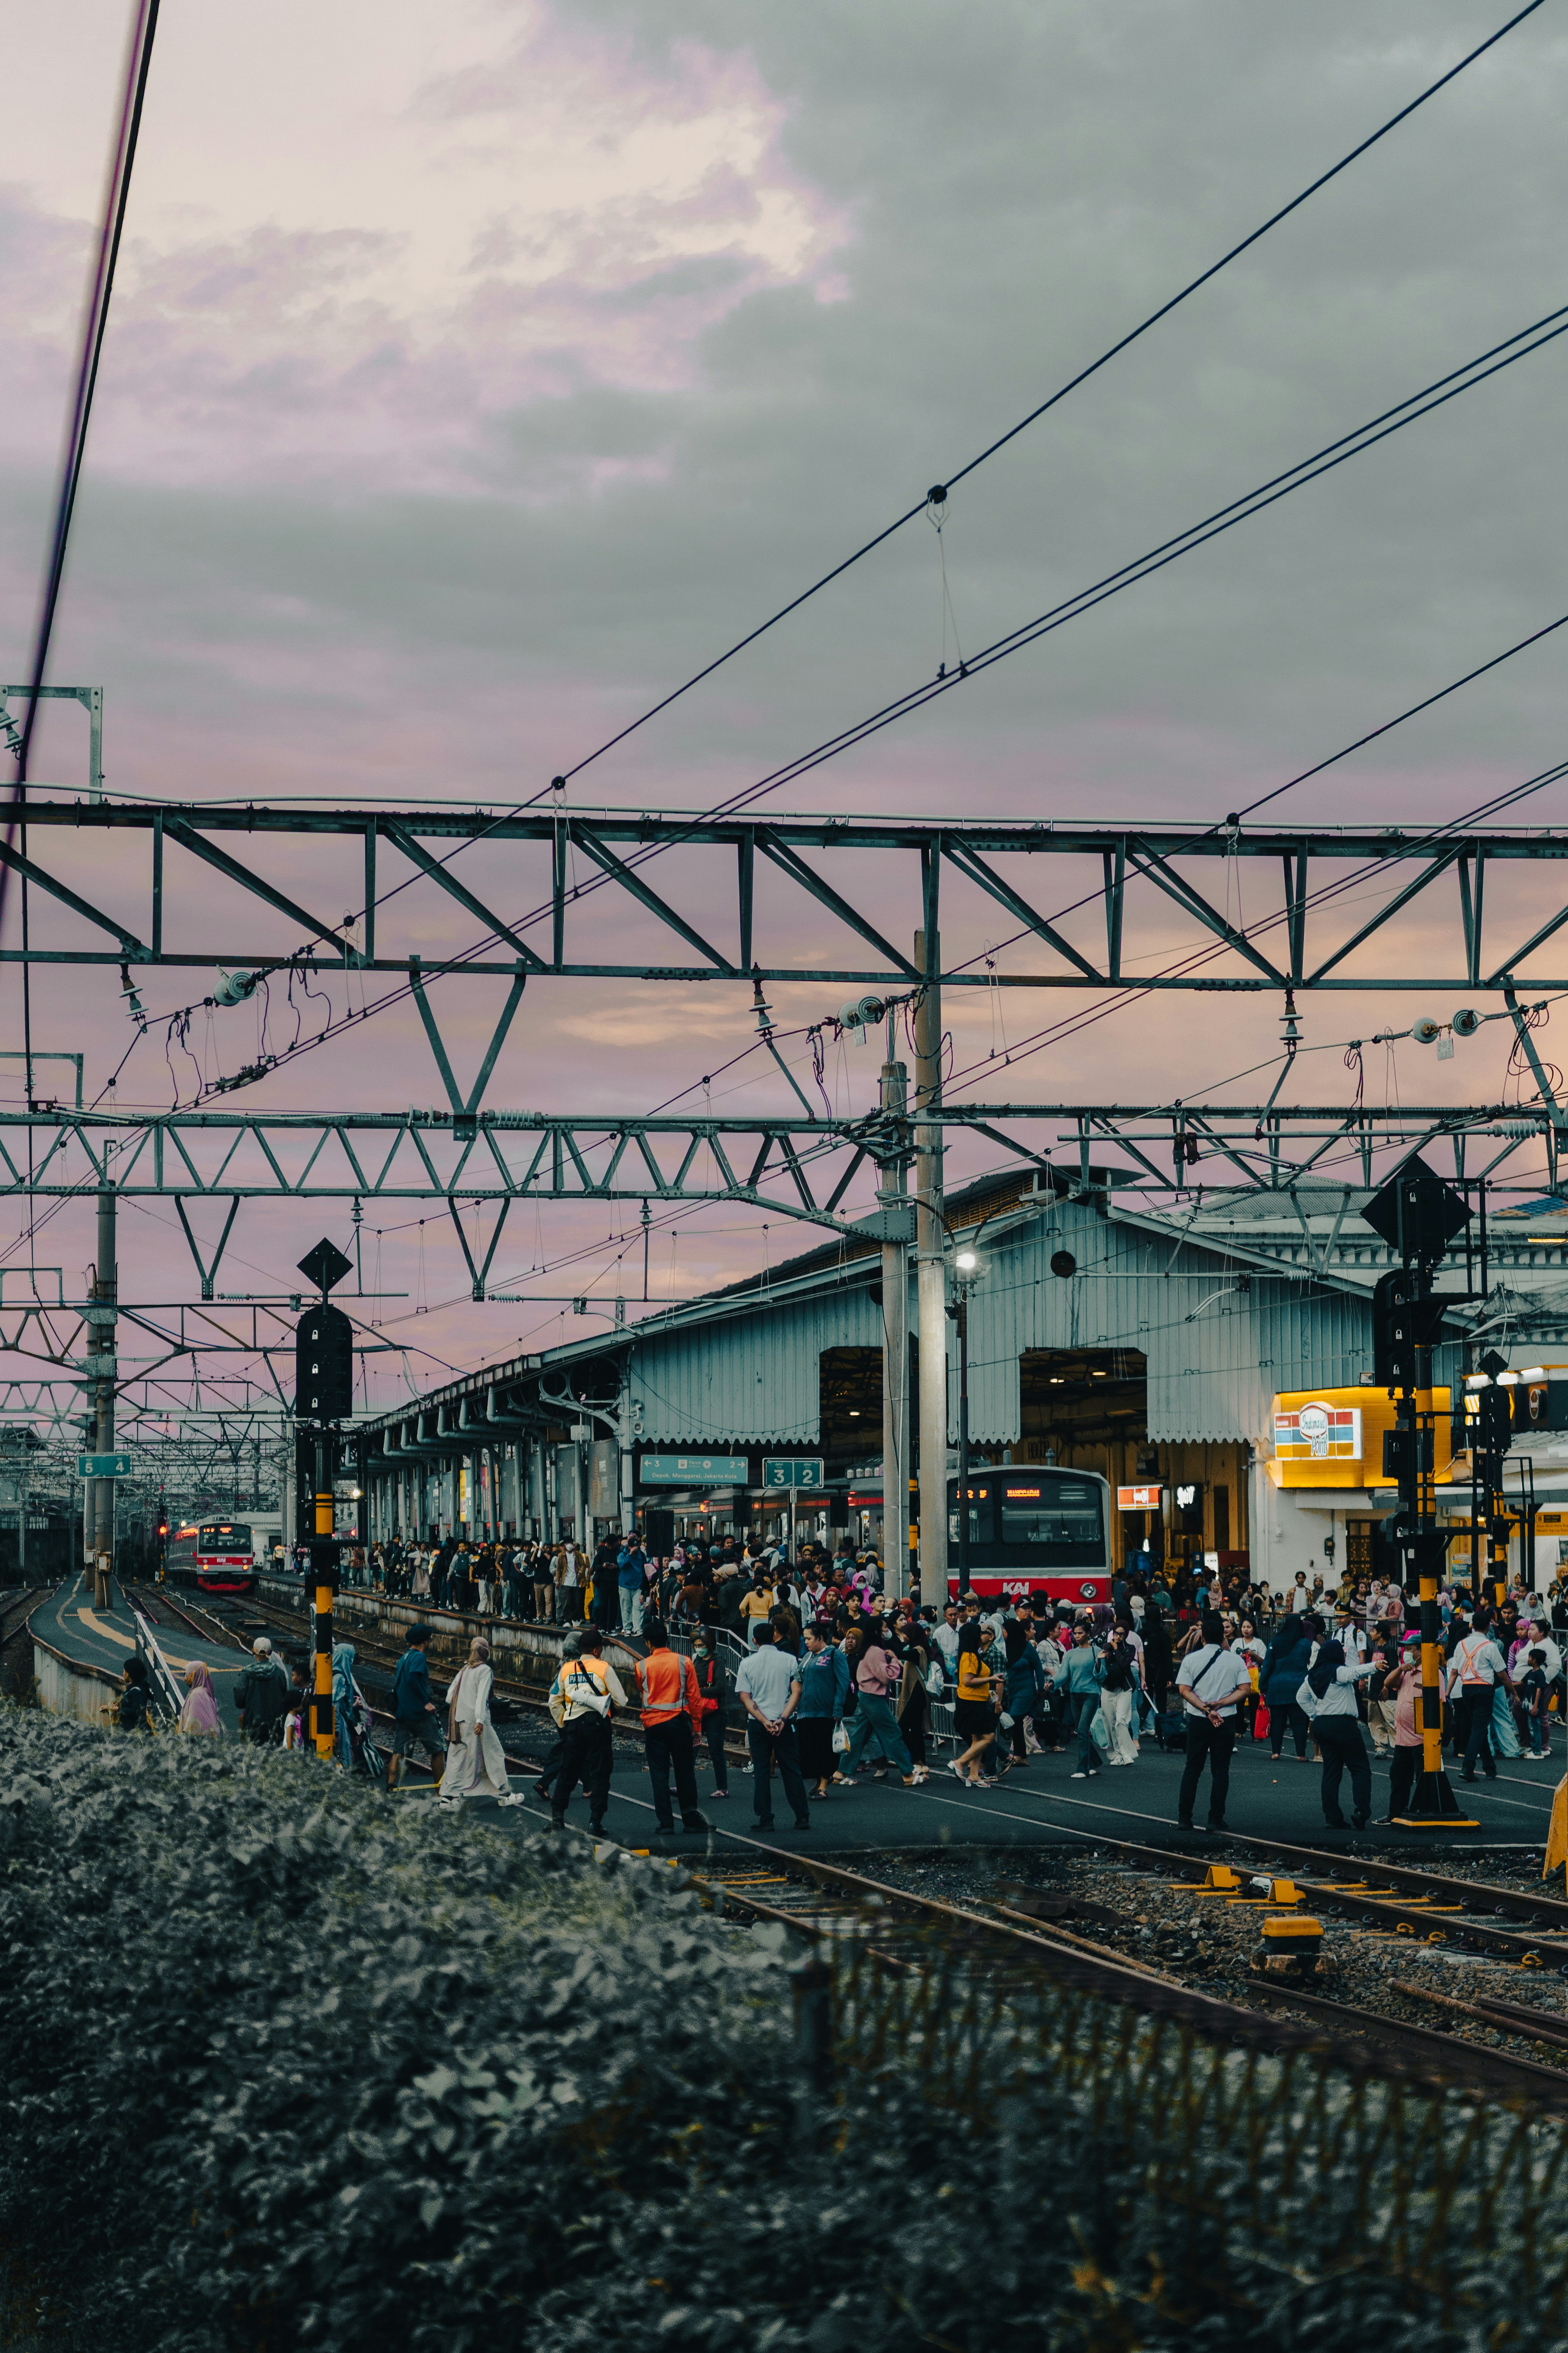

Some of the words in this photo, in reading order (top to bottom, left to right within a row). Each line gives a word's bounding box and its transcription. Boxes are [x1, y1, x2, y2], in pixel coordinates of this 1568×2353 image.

[1301, 1414, 1325, 1430] Indomaret
[1312, 1435, 1327, 1455] Point
[85, 1462, 93, 1473] 5
[115, 1462, 124, 1472] 4
[774, 1469, 785, 1484] 3
[802, 1469, 813, 1483] 2
[1003, 1581, 1029, 1595] KAI
